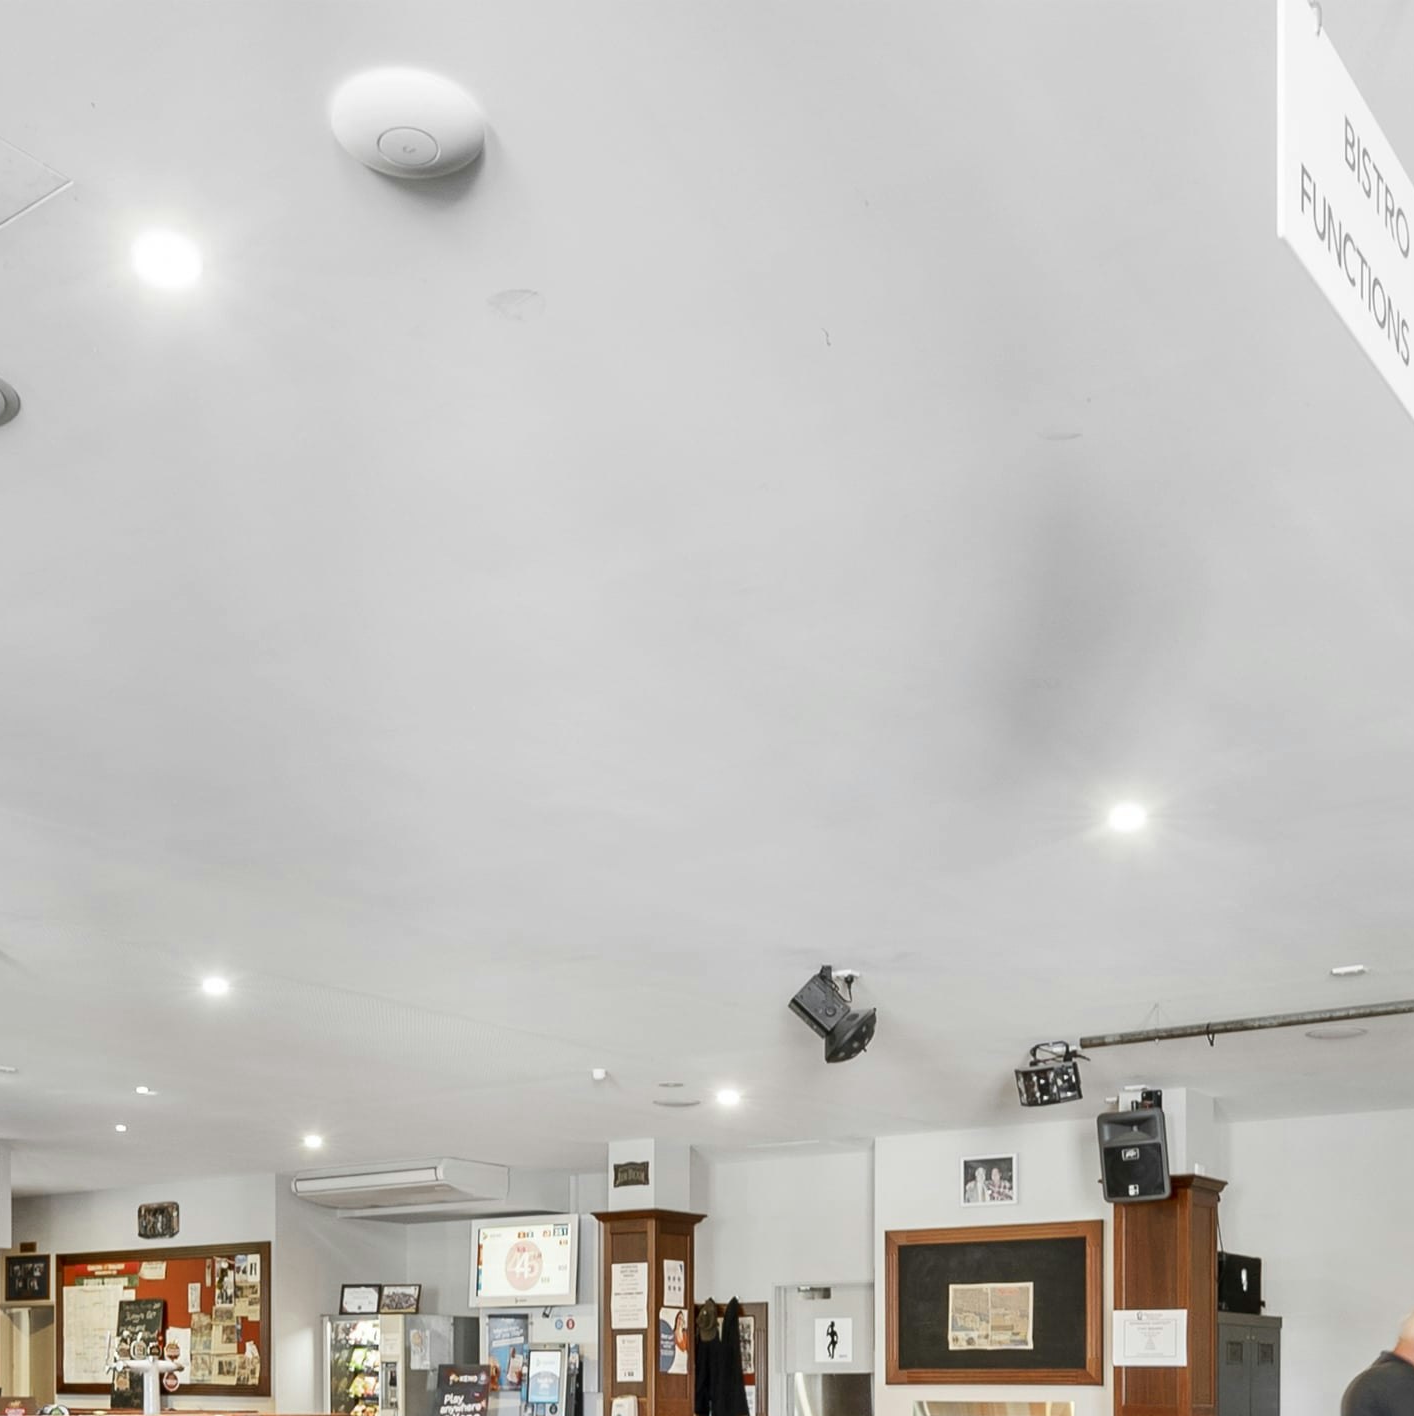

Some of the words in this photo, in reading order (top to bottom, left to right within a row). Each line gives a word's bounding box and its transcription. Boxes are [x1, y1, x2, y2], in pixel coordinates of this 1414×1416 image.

[1344, 114, 1410, 259] BISTRO
[1300, 162, 1410, 367] FUNCTIONS
[440, 1402, 482, 1416] anywhere
[443, 1392, 465, 1405] Play
